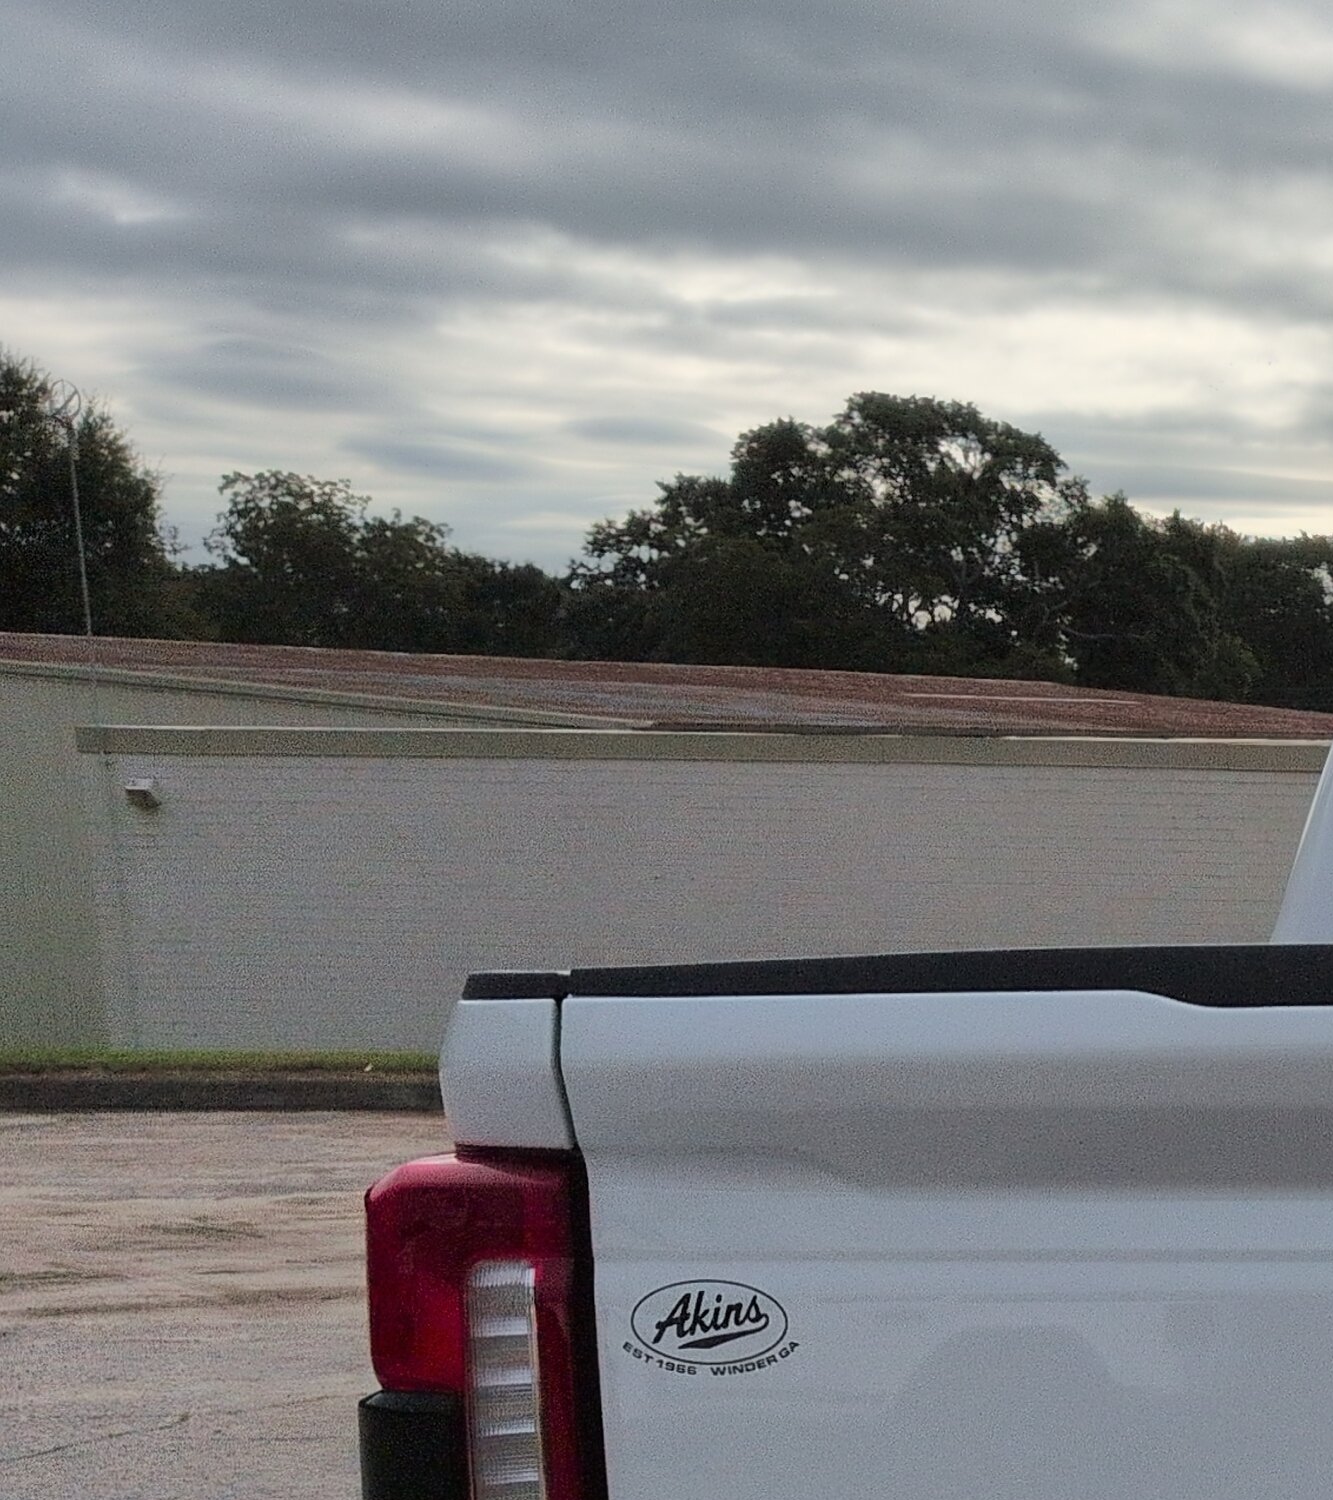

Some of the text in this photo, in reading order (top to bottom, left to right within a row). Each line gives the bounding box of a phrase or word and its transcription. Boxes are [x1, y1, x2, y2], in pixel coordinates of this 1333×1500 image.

[652, 1290, 769, 1349] Akins
[622, 1341, 654, 1363] EST
[710, 1341, 800, 1376] WINDER GA
